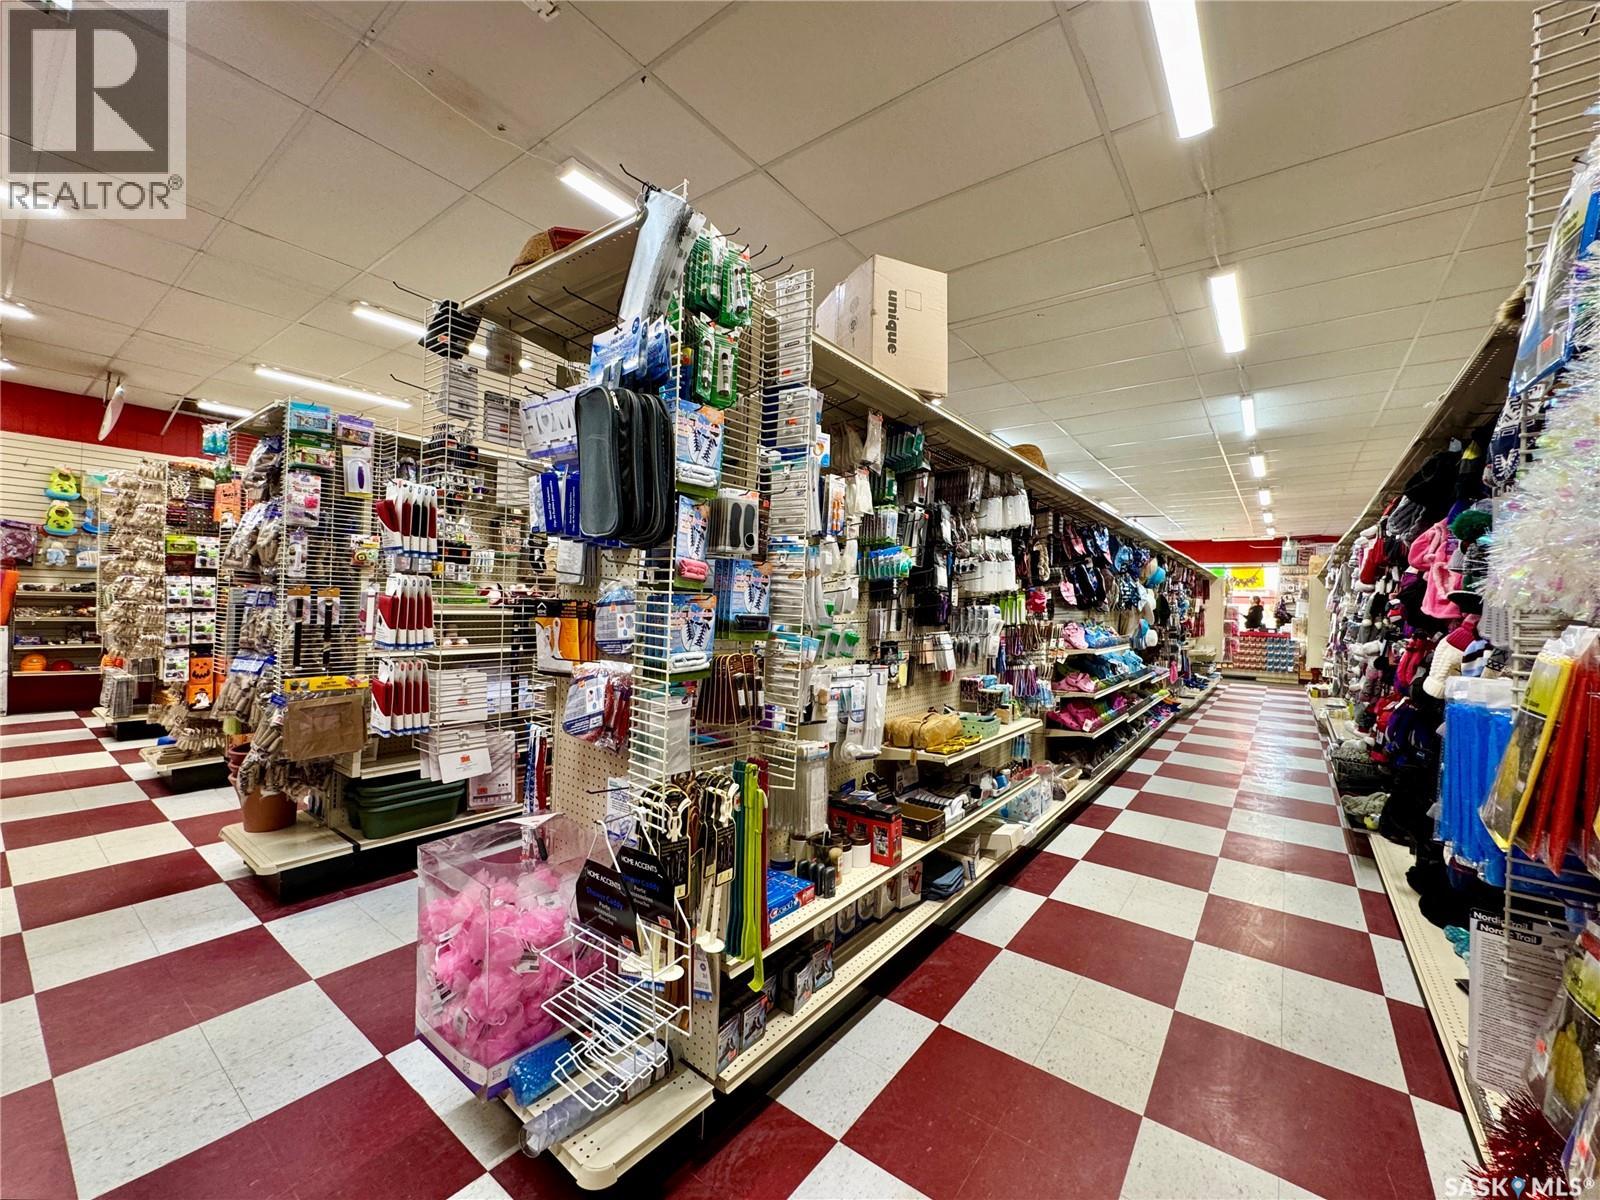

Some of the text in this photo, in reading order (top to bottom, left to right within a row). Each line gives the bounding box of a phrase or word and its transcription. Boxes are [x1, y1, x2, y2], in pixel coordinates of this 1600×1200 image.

[885, 289, 899, 355] unique
[622, 856, 658, 873] HOME ACCENTS
[587, 870, 621, 891] HOME ACCENTS
[1480, 923, 1538, 945] Nordc Trail
